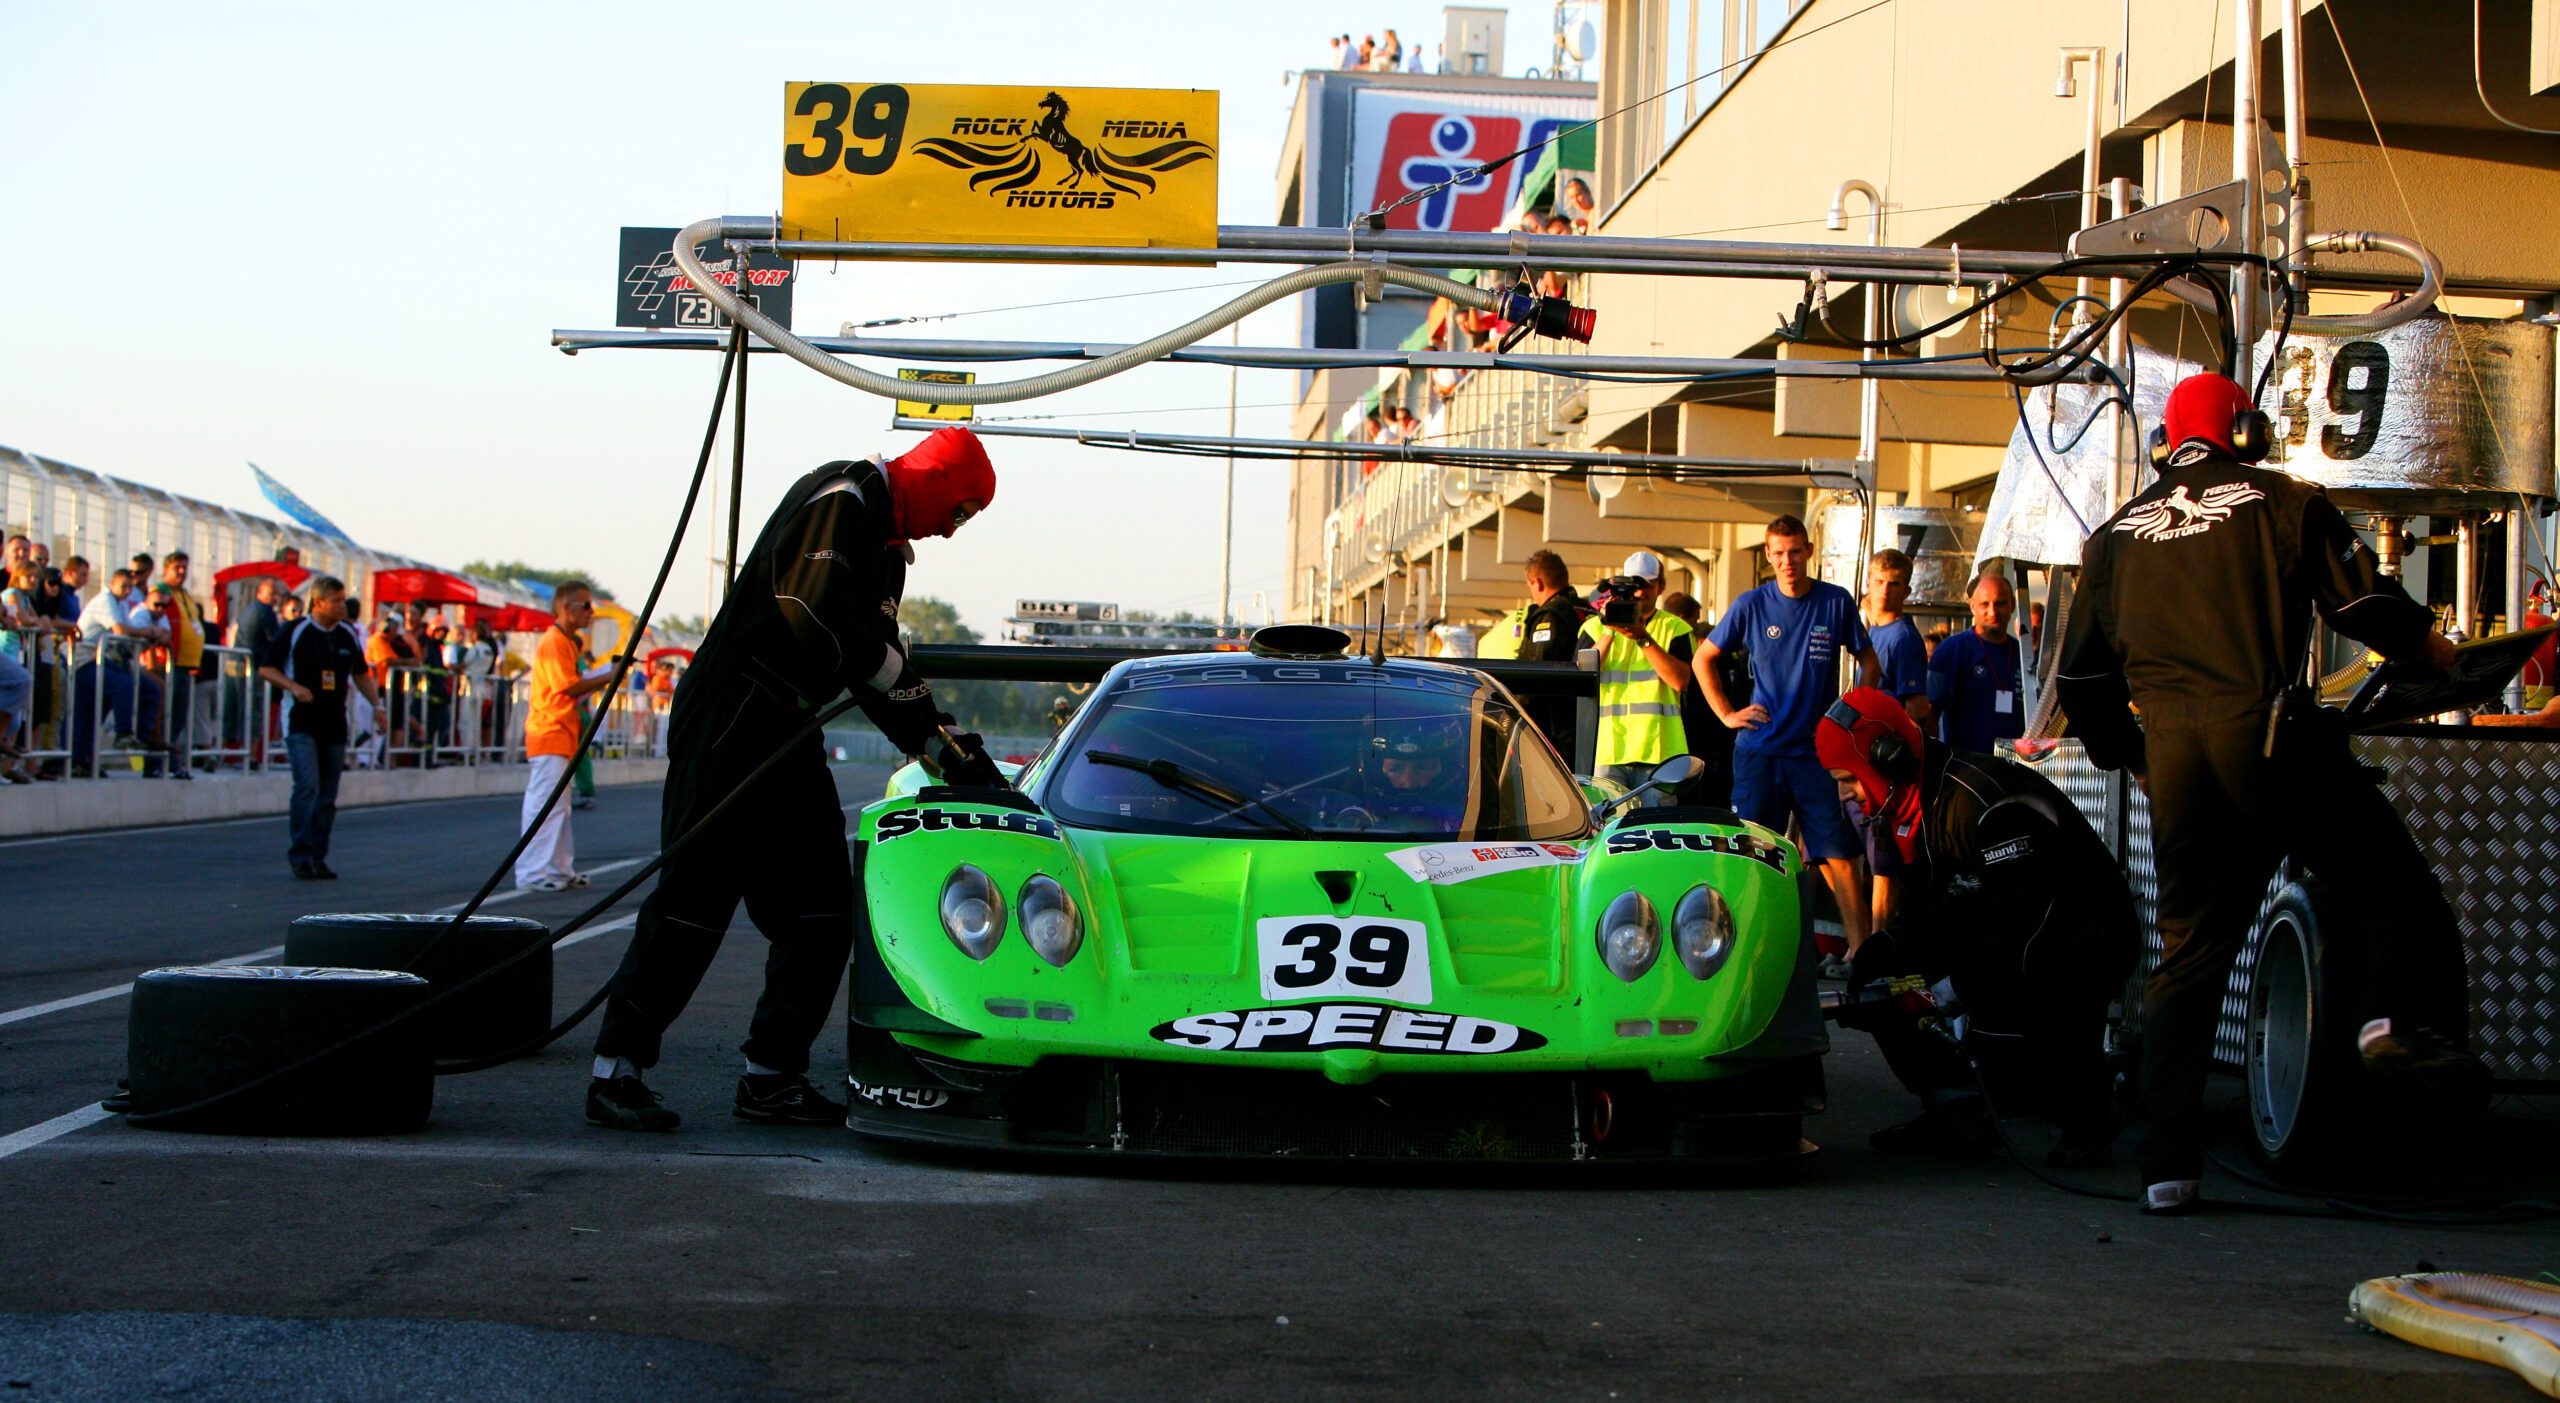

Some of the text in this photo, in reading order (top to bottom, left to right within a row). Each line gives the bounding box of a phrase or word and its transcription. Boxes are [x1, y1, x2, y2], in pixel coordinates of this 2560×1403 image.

[785, 83, 910, 176] 39
[952, 117, 1187, 139] ROCK MEDIA
[1006, 190, 1116, 209] MOTORS
[681, 297, 713, 324] 23
[2128, 482, 2250, 516] ROCK MEDIA
[2153, 520, 2211, 543] MOTORS
[877, 808, 1062, 845] Stuff
[1498, 850, 1537, 859] KENO
[1607, 829, 1787, 876] Stuff
[1273, 923, 1410, 988] 39
[1163, 1006, 1519, 1053] SPEED
